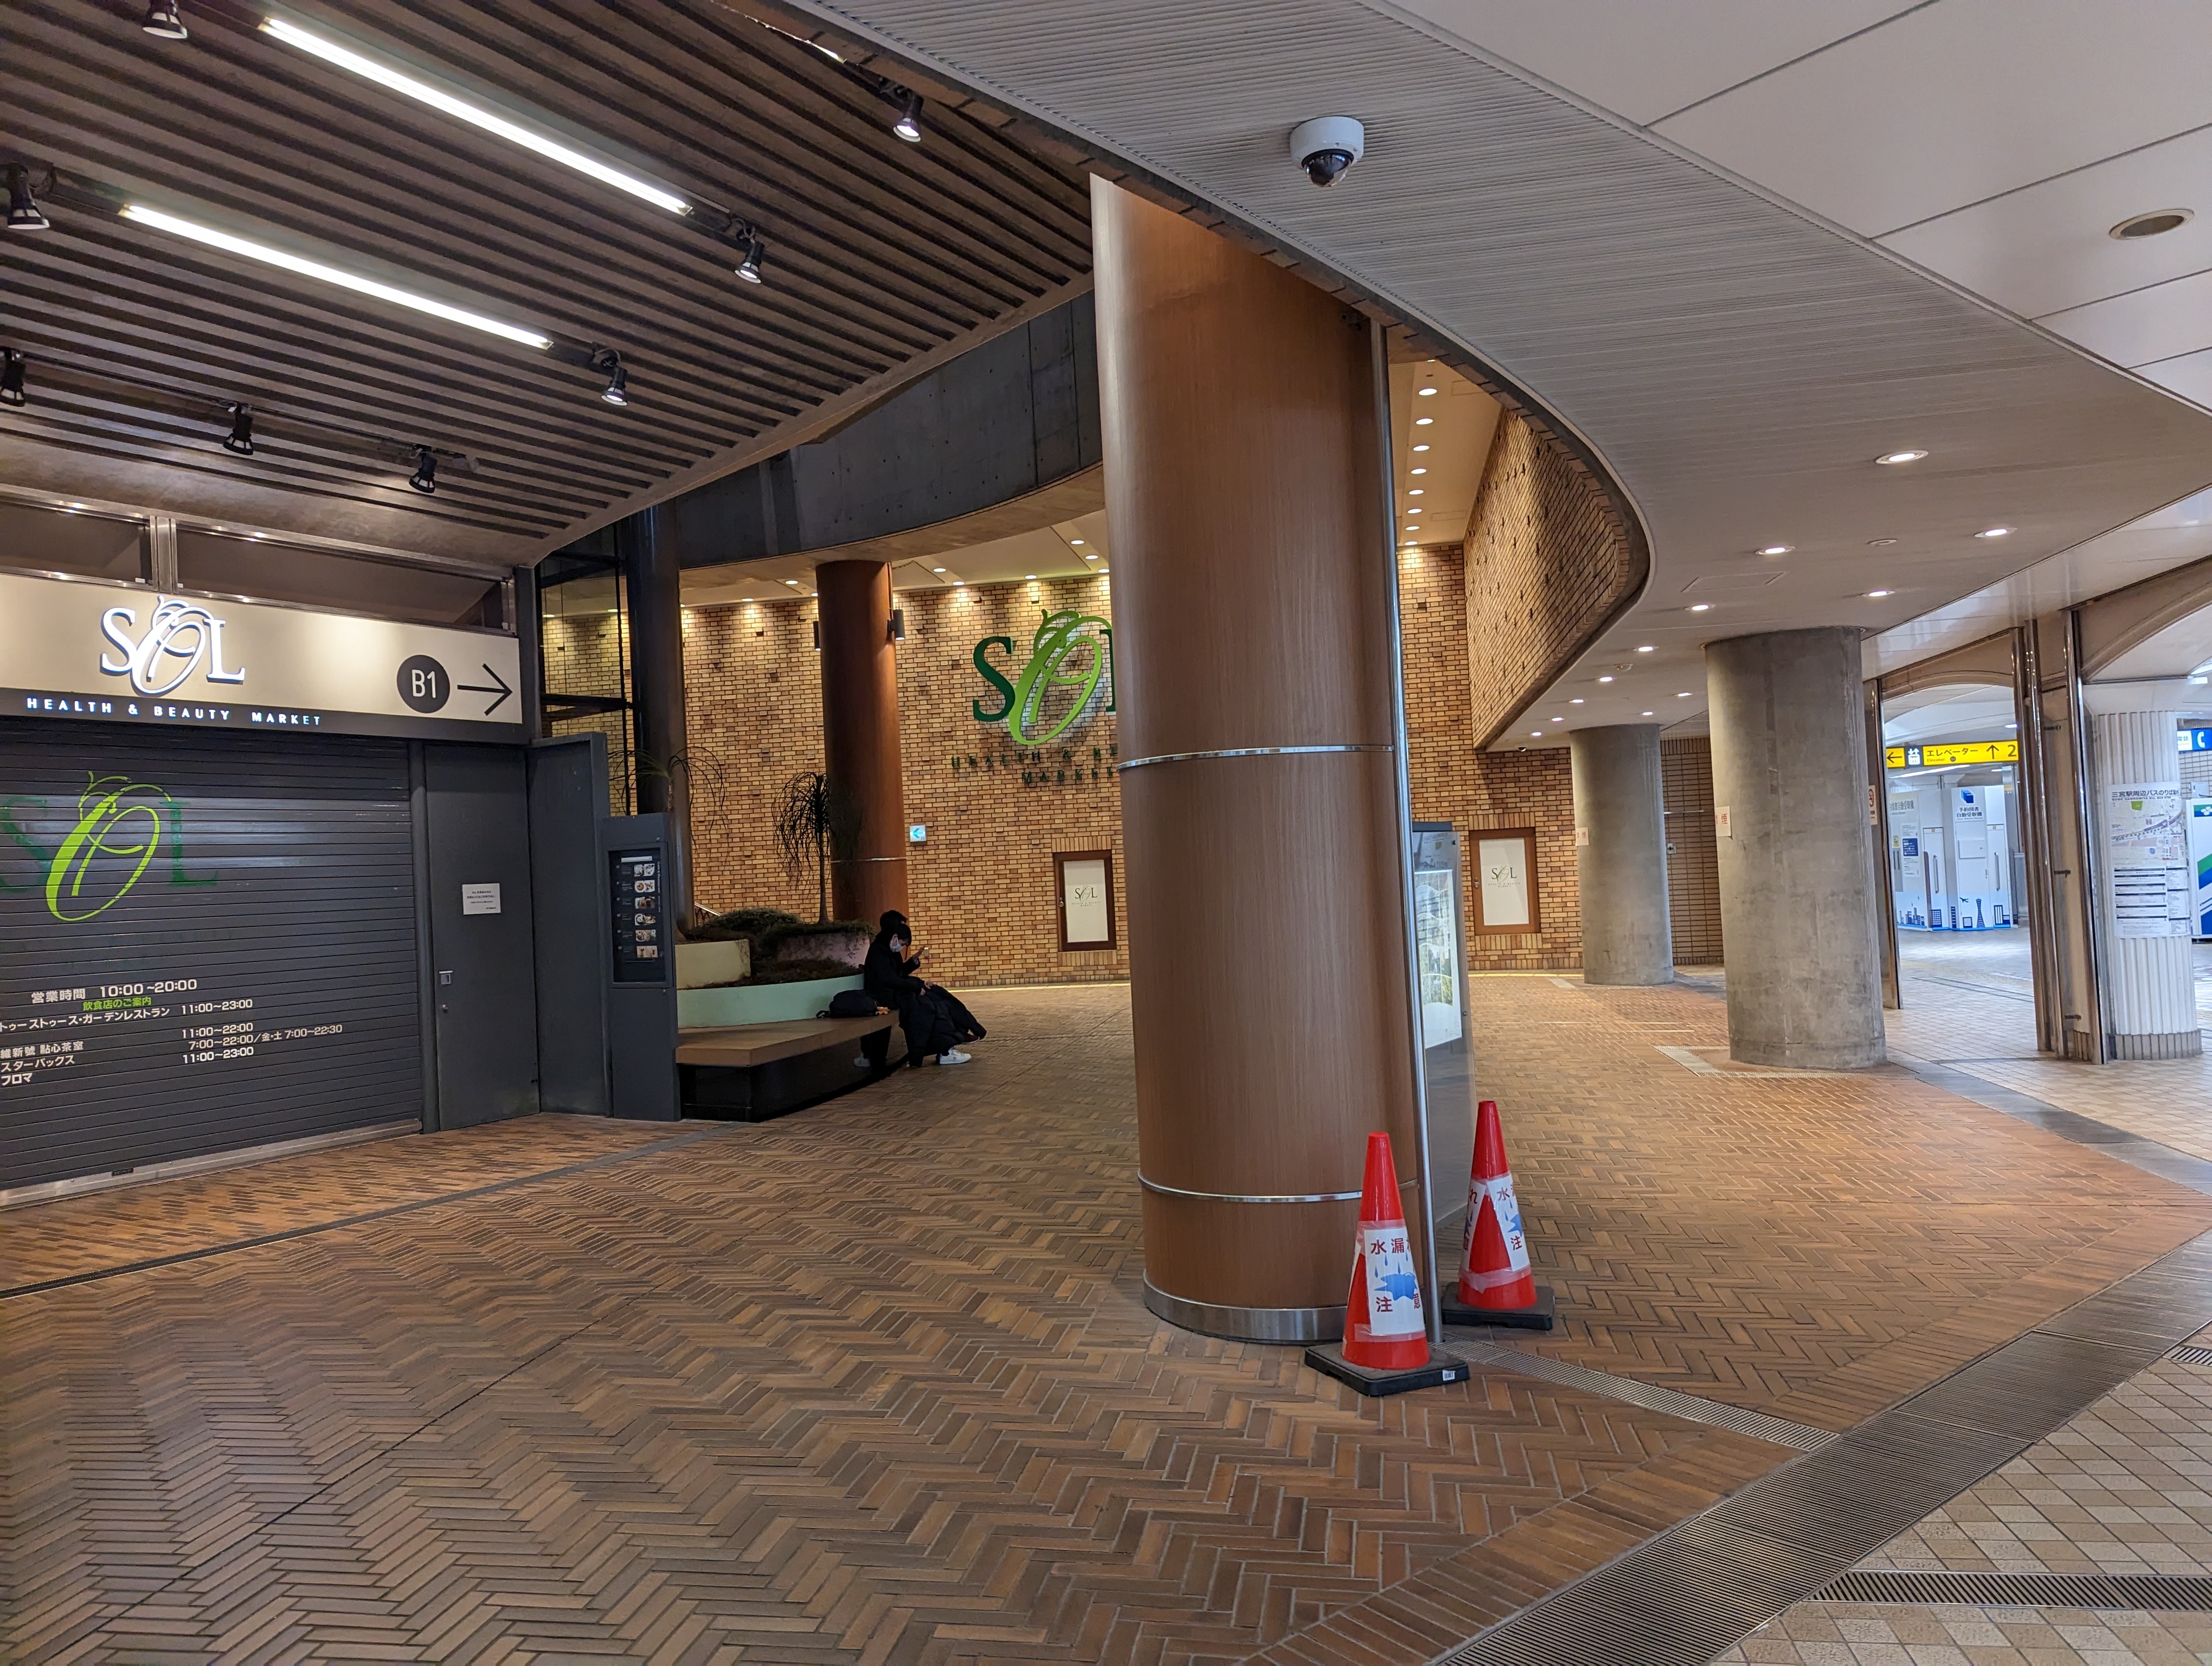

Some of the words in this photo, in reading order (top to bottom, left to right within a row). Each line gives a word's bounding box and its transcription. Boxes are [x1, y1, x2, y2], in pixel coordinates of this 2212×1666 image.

[101, 594, 245, 695] SOL
[411, 669, 436, 699] B1
[27, 697, 111, 713] HEALTH
[128, 704, 138, 715] &
[154, 706, 229, 720] BEAUTY
[252, 712, 320, 725] MARKET
[951, 751, 1041, 768] HEALTH
[1063, 749, 1071, 760] &
[1926, 748, 1978, 757] エレベーター
[2007, 745, 2017, 757] 2
[1022, 766, 1113, 784] MARKET
[31, 988, 86, 1004] 営業時間
[83, 996, 152, 1011] 飲食店のご案内
[182, 999, 253, 1015] 11:00~23:00
[182, 1022, 253, 1039] 11:00~22:00
[1, 1055, 75, 1073] スターバックス
[1, 1073, 33, 1086] フロマ
[183, 1046, 254, 1063] 11:00~23:00
